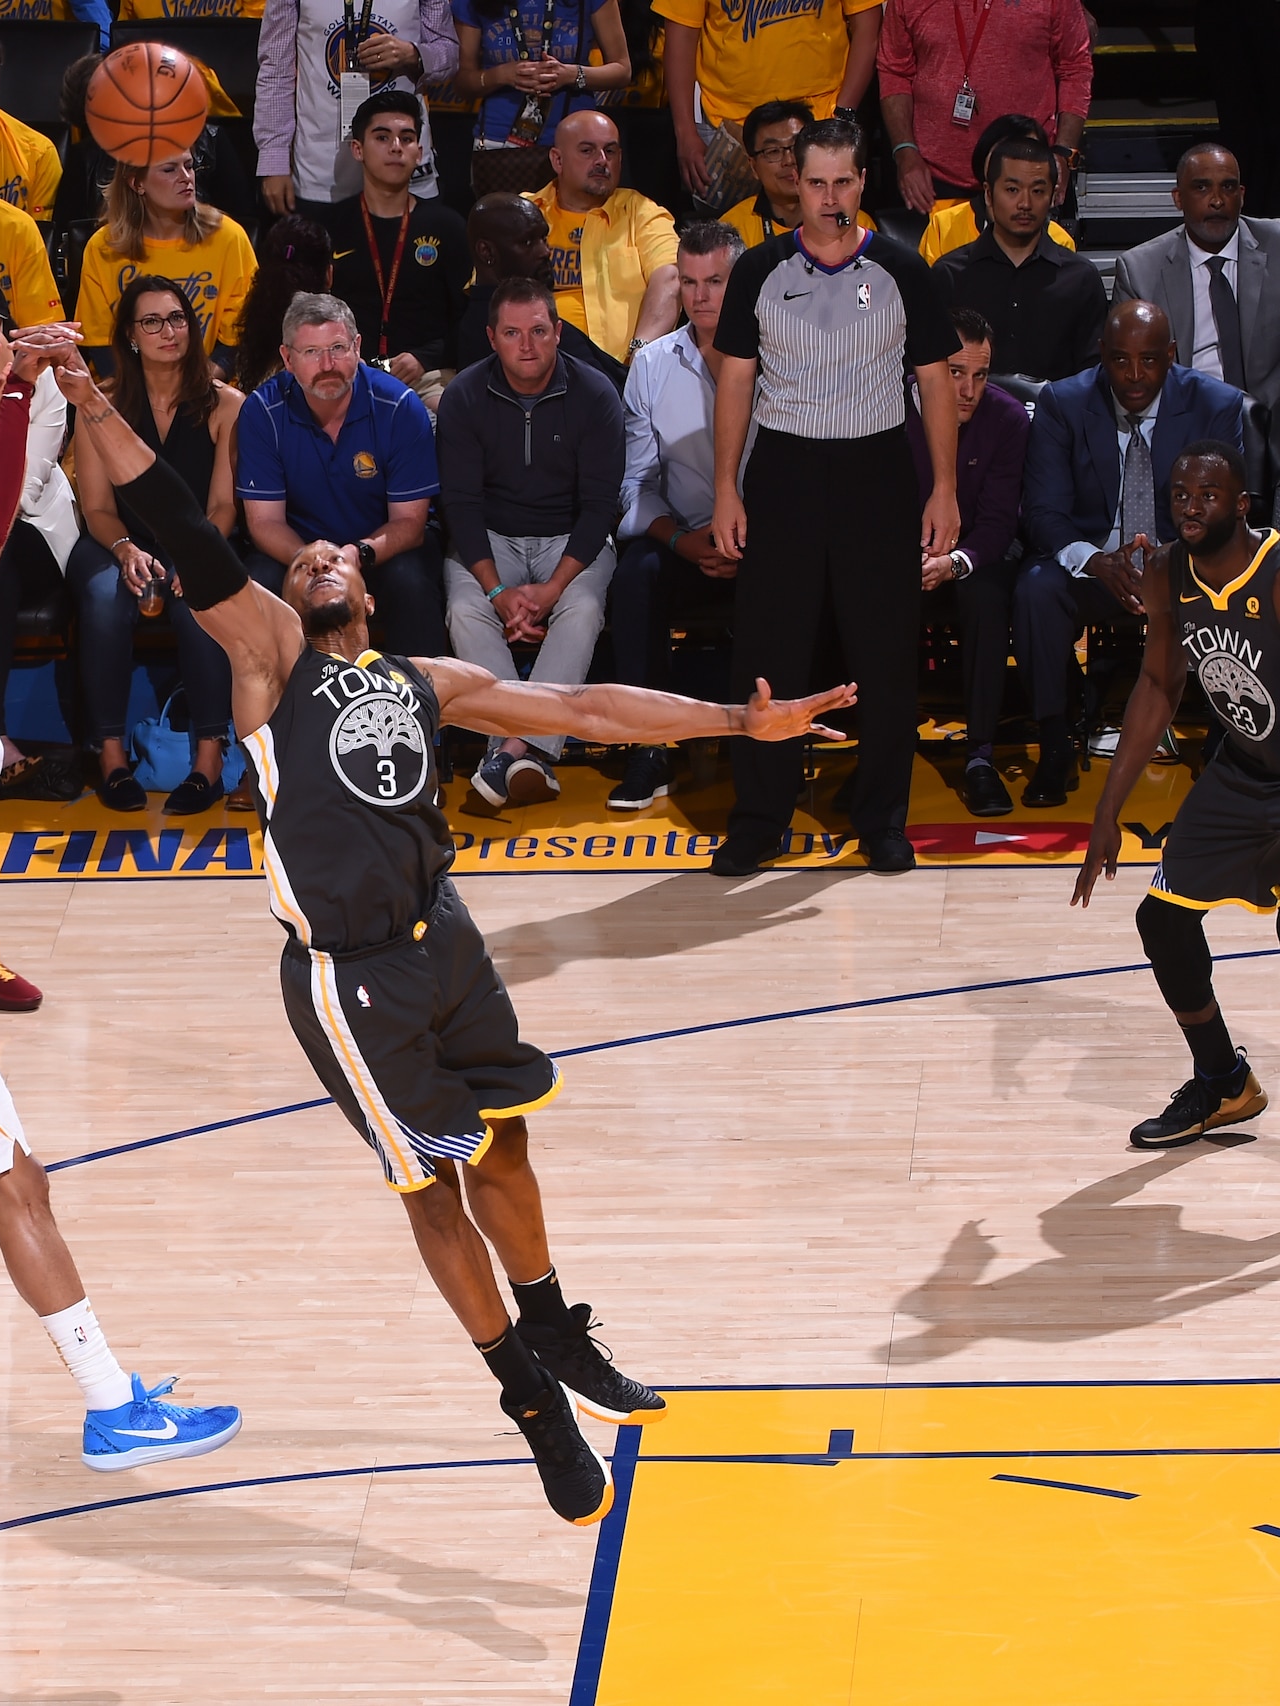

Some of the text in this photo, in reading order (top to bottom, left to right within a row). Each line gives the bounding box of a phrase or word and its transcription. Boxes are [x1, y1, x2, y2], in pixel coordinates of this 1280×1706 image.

[1181, 624, 1263, 671] TOWN
[321, 663, 339, 679] The
[311, 667, 421, 714] TOWN
[1226, 702, 1258, 735] 23
[376, 759, 397, 797] 3
[0, 828, 260, 874] FINA
[453, 827, 859, 859] Presente by
